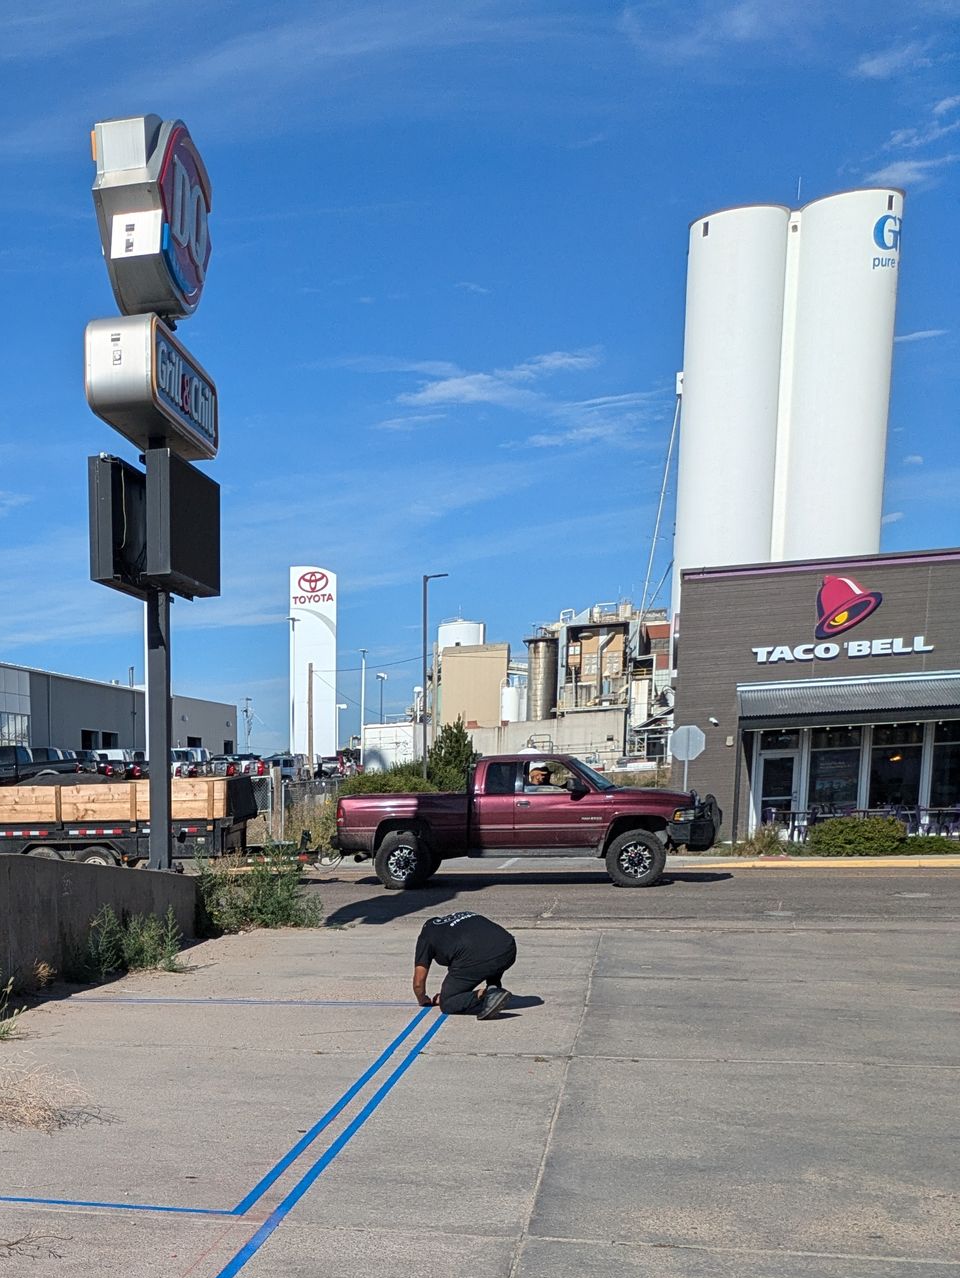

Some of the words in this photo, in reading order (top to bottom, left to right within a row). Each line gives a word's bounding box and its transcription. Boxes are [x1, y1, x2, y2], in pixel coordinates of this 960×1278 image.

[872, 256, 896, 270] pure
[158, 341, 183, 407] Grill
[183, 374, 191, 413] &
[191, 377, 215, 437] Chill
[292, 593, 333, 604] TOYOTA
[752, 643, 840, 663] TACO
[844, 636, 934, 658] BELL
